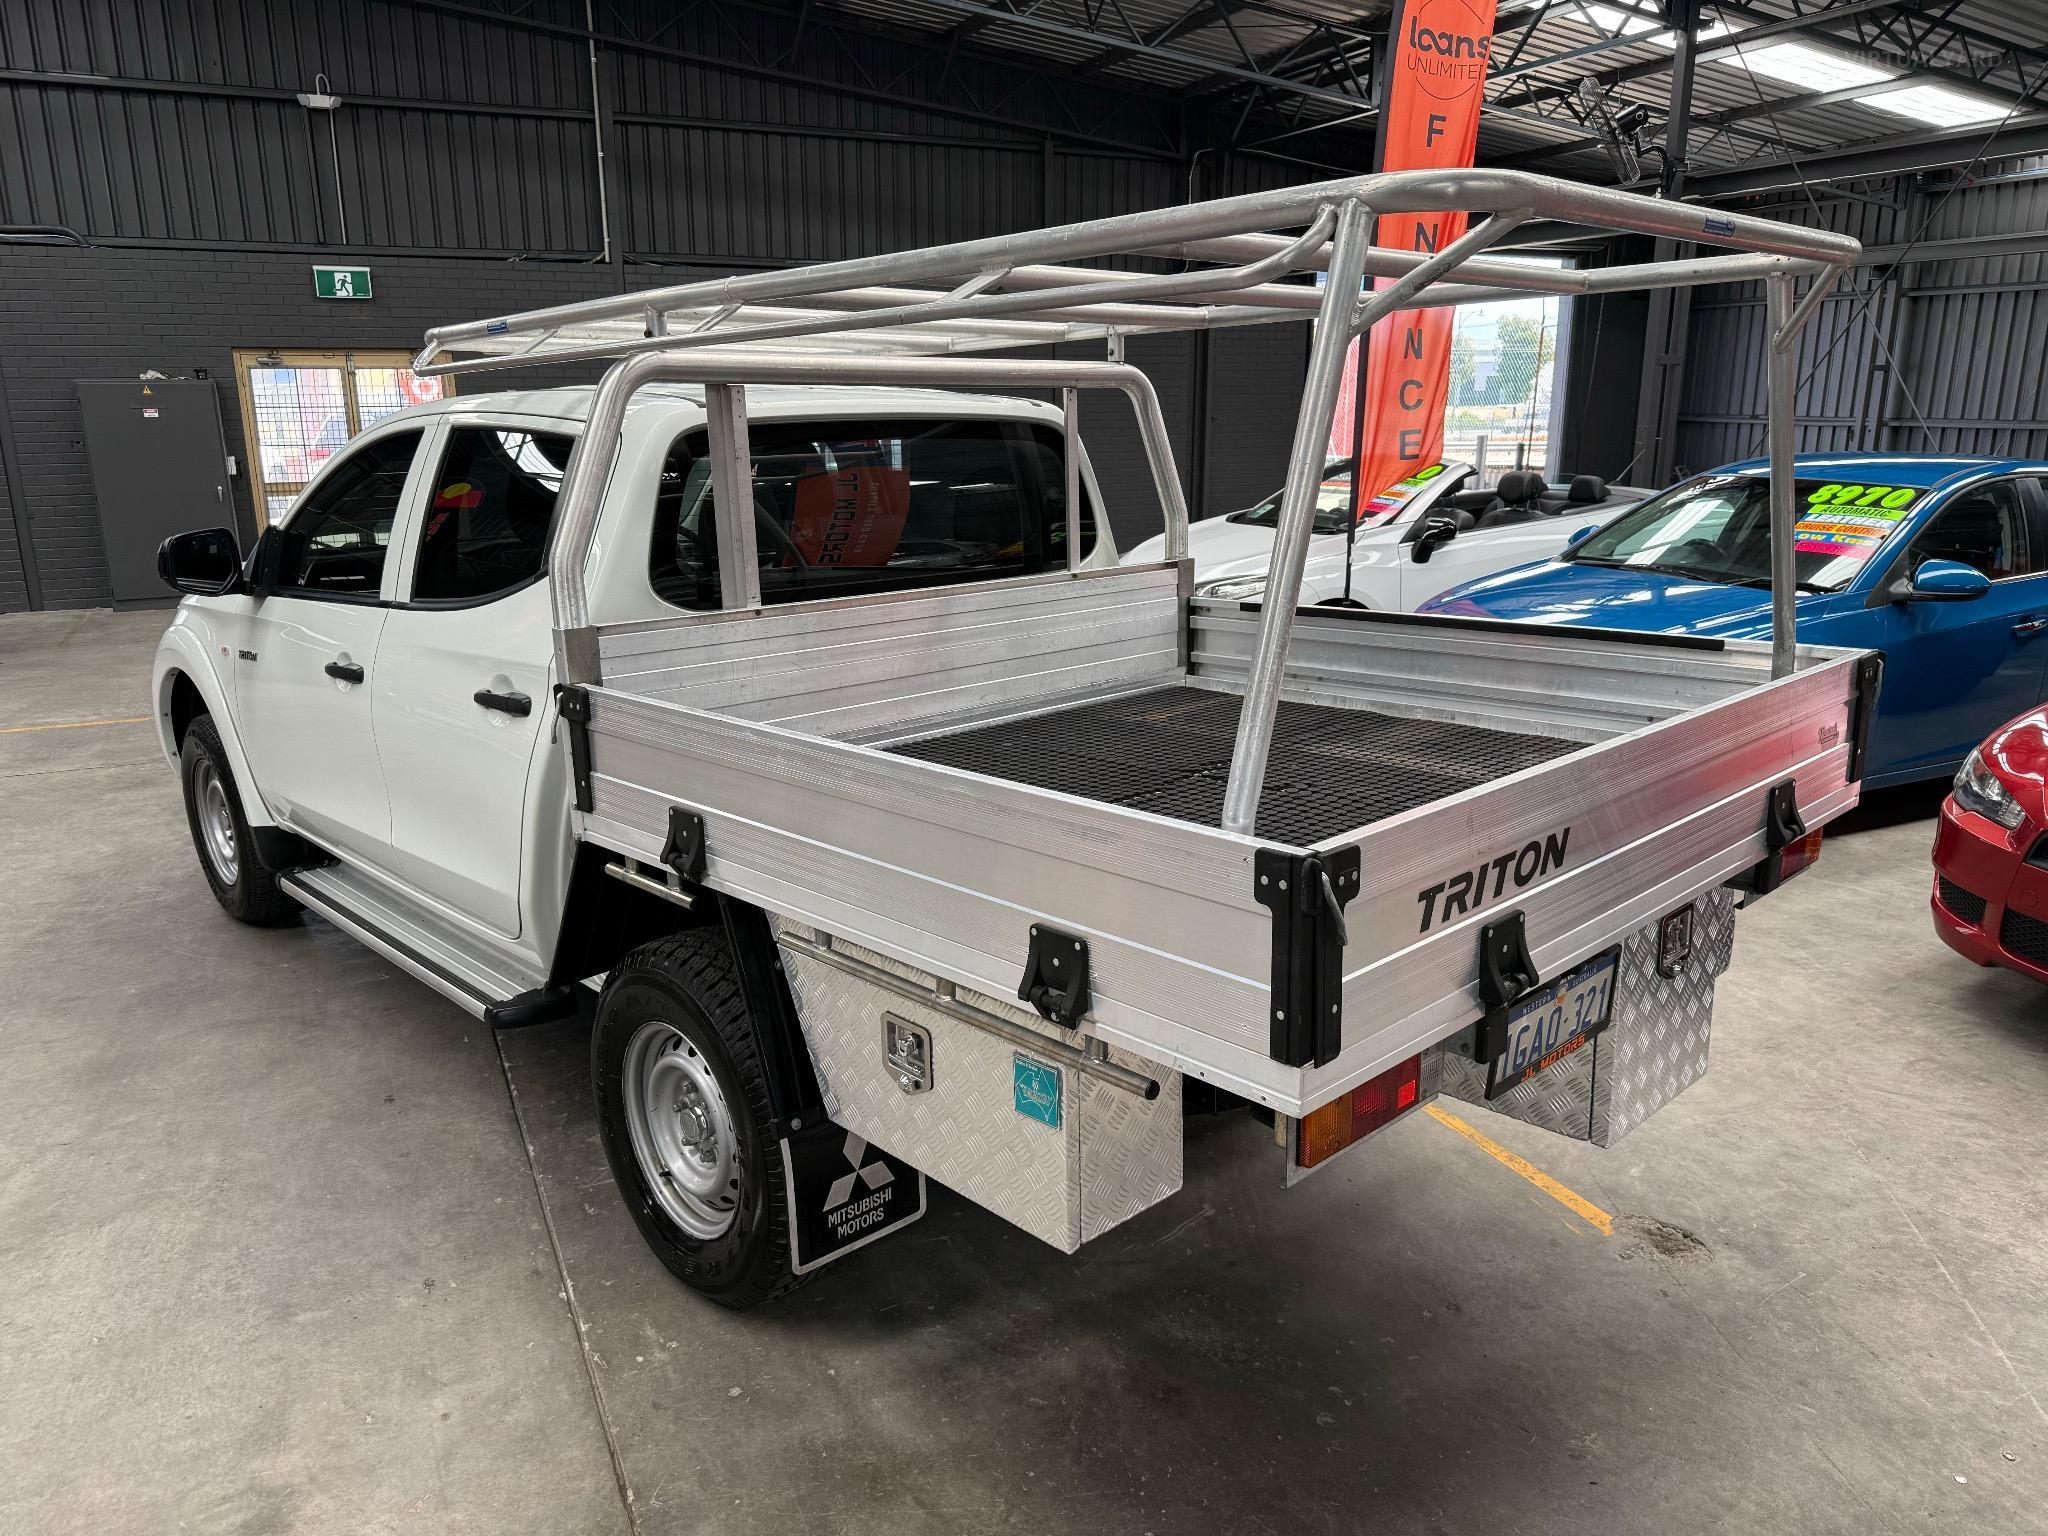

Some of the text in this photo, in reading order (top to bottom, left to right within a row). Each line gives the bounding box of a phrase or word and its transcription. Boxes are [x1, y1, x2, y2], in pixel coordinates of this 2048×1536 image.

[1410, 16, 1490, 59] loans
[1807, 484, 1916, 508] 8970
[1805, 513, 1895, 529] LEATHER
[1820, 506, 1892, 518] AUTOMATIC
[1795, 522, 1834, 532] CRUISE
[1795, 533, 1827, 541] ow
[1417, 826, 1571, 934] TRITON
[1522, 994, 1551, 1016] WESTERN
[1521, 1034, 1586, 1082] JL MOTORS
[828, 1186, 892, 1228] MITSUBISHI
[837, 1207, 885, 1239] MOTORS
